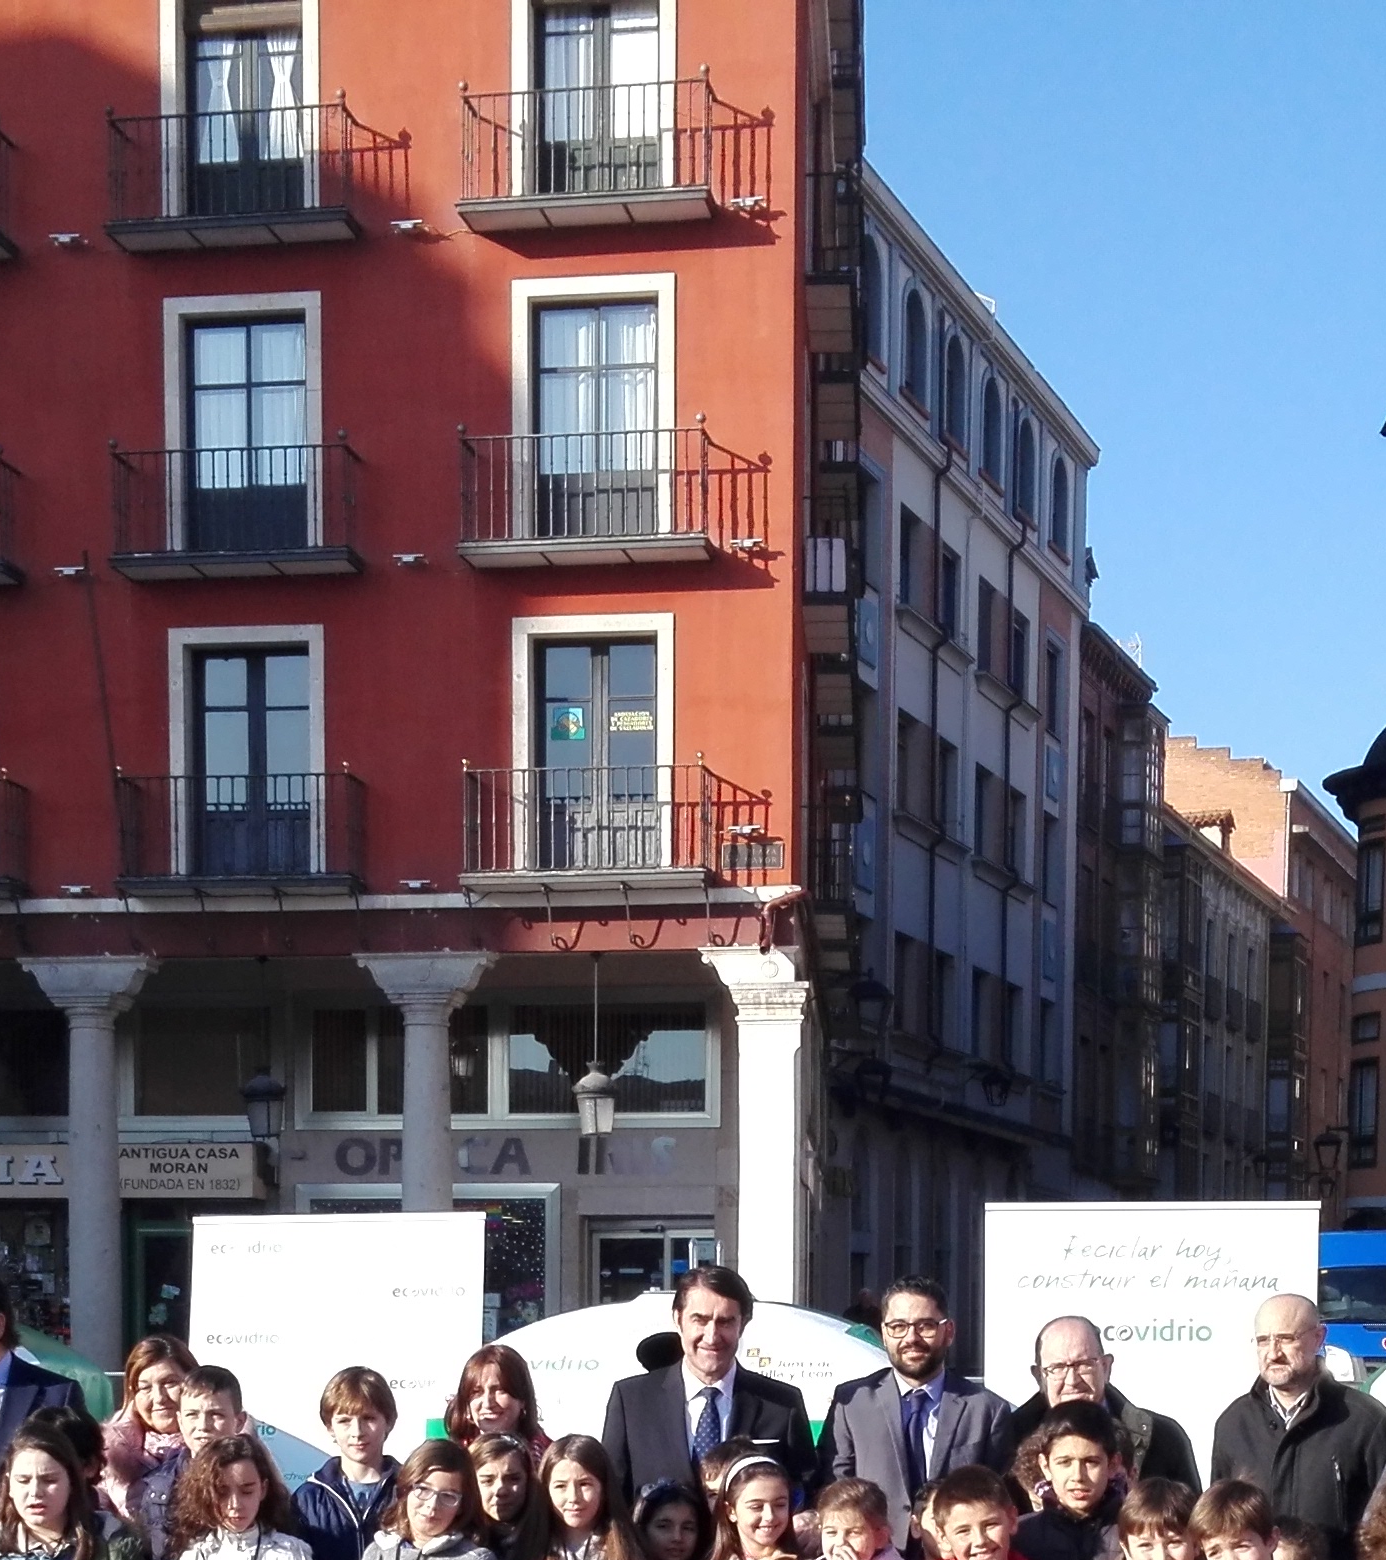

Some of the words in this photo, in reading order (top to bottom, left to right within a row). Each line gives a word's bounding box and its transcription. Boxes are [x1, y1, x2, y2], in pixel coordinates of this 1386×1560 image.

[119, 1147, 191, 1160] ANTIGUA
[195, 1147, 240, 1159] CASA
[334, 1137, 531, 1176] OPCA
[149, 1162, 209, 1174] MORAN
[119, 1178, 184, 1190] (FUNDADA
[187, 1178, 205, 1190] EN
[209, 1178, 241, 1190] 1832)
[210, 1239, 284, 1255] ecidrio
[1062, 1234, 1163, 1261] Reciclar
[1175, 1238, 1233, 1272] hoy,
[1016, 1268, 1136, 1290] construir
[1149, 1266, 1174, 1289] el
[1183, 1269, 1280, 1292] mañana
[391, 1285, 466, 1298] ecovidio
[1099, 1317, 1213, 1343] covidrio
[206, 1331, 281, 1346] ecovidrio
[529, 1355, 600, 1371] vidrio
